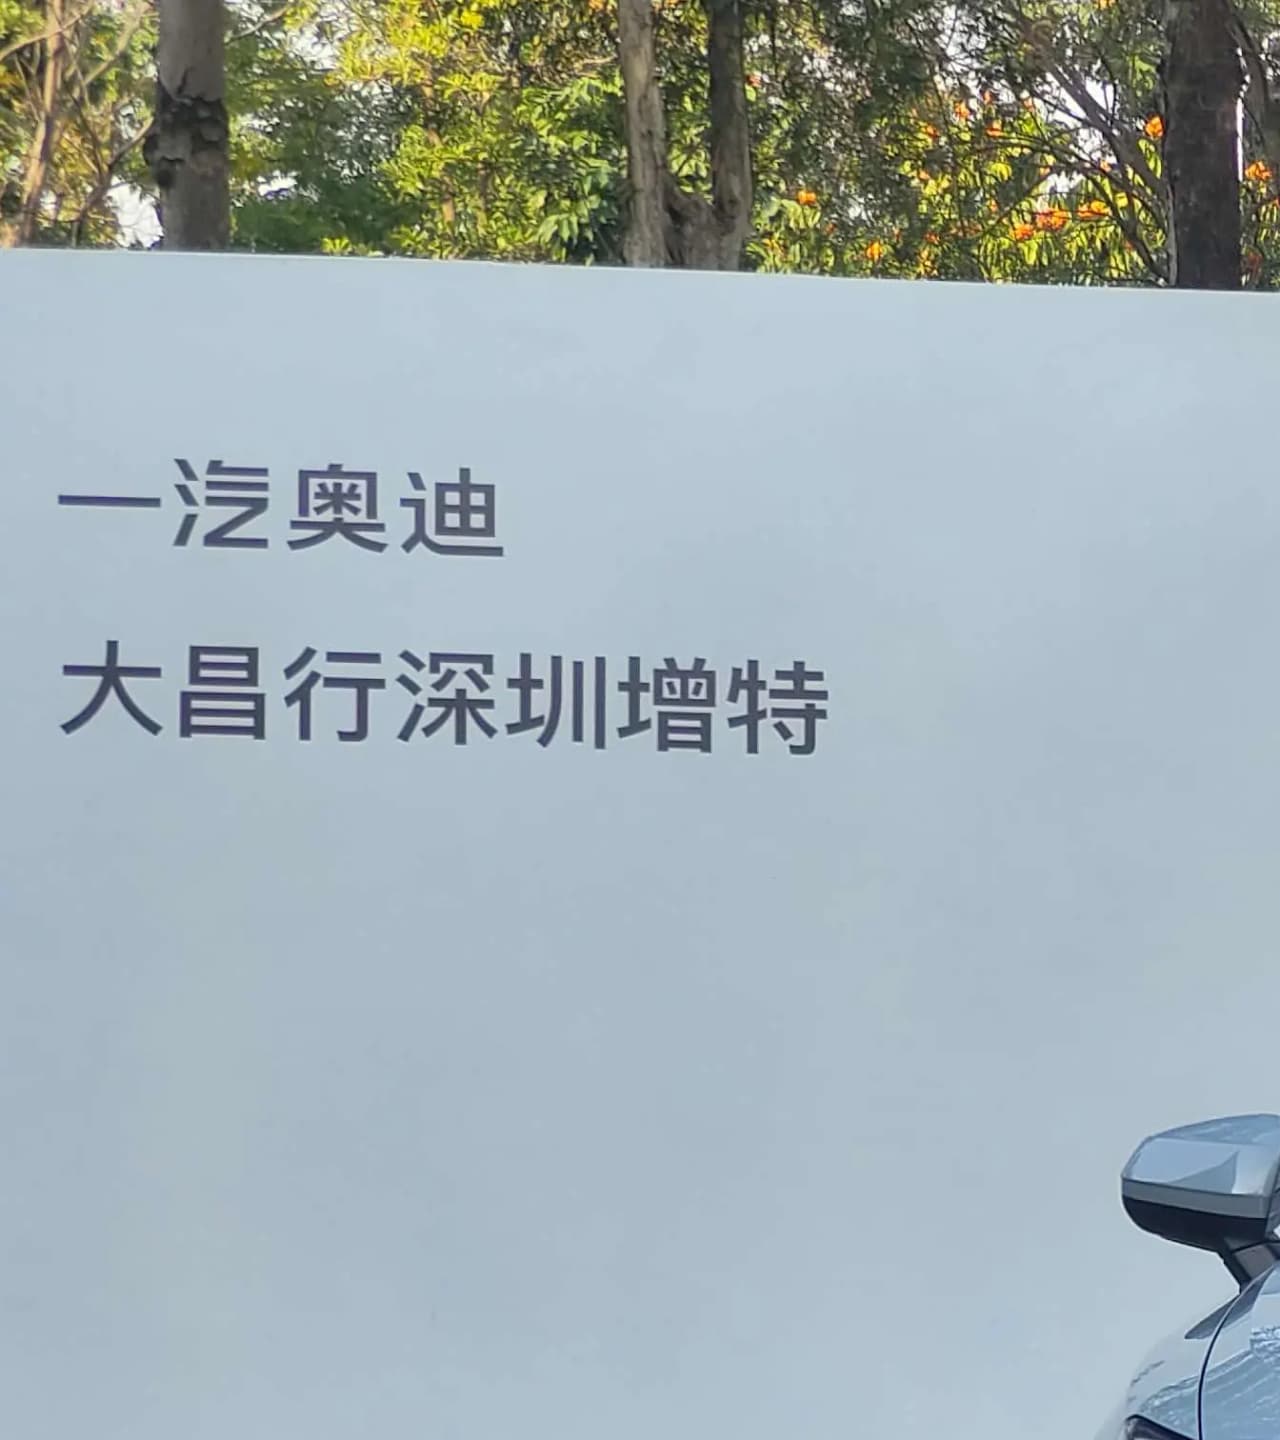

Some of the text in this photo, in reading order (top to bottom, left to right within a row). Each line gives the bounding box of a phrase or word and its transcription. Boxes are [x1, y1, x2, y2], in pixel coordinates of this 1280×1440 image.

[57, 458, 504, 557] 一汽奥迪
[59, 639, 829, 756] 大昌行深圳增特
